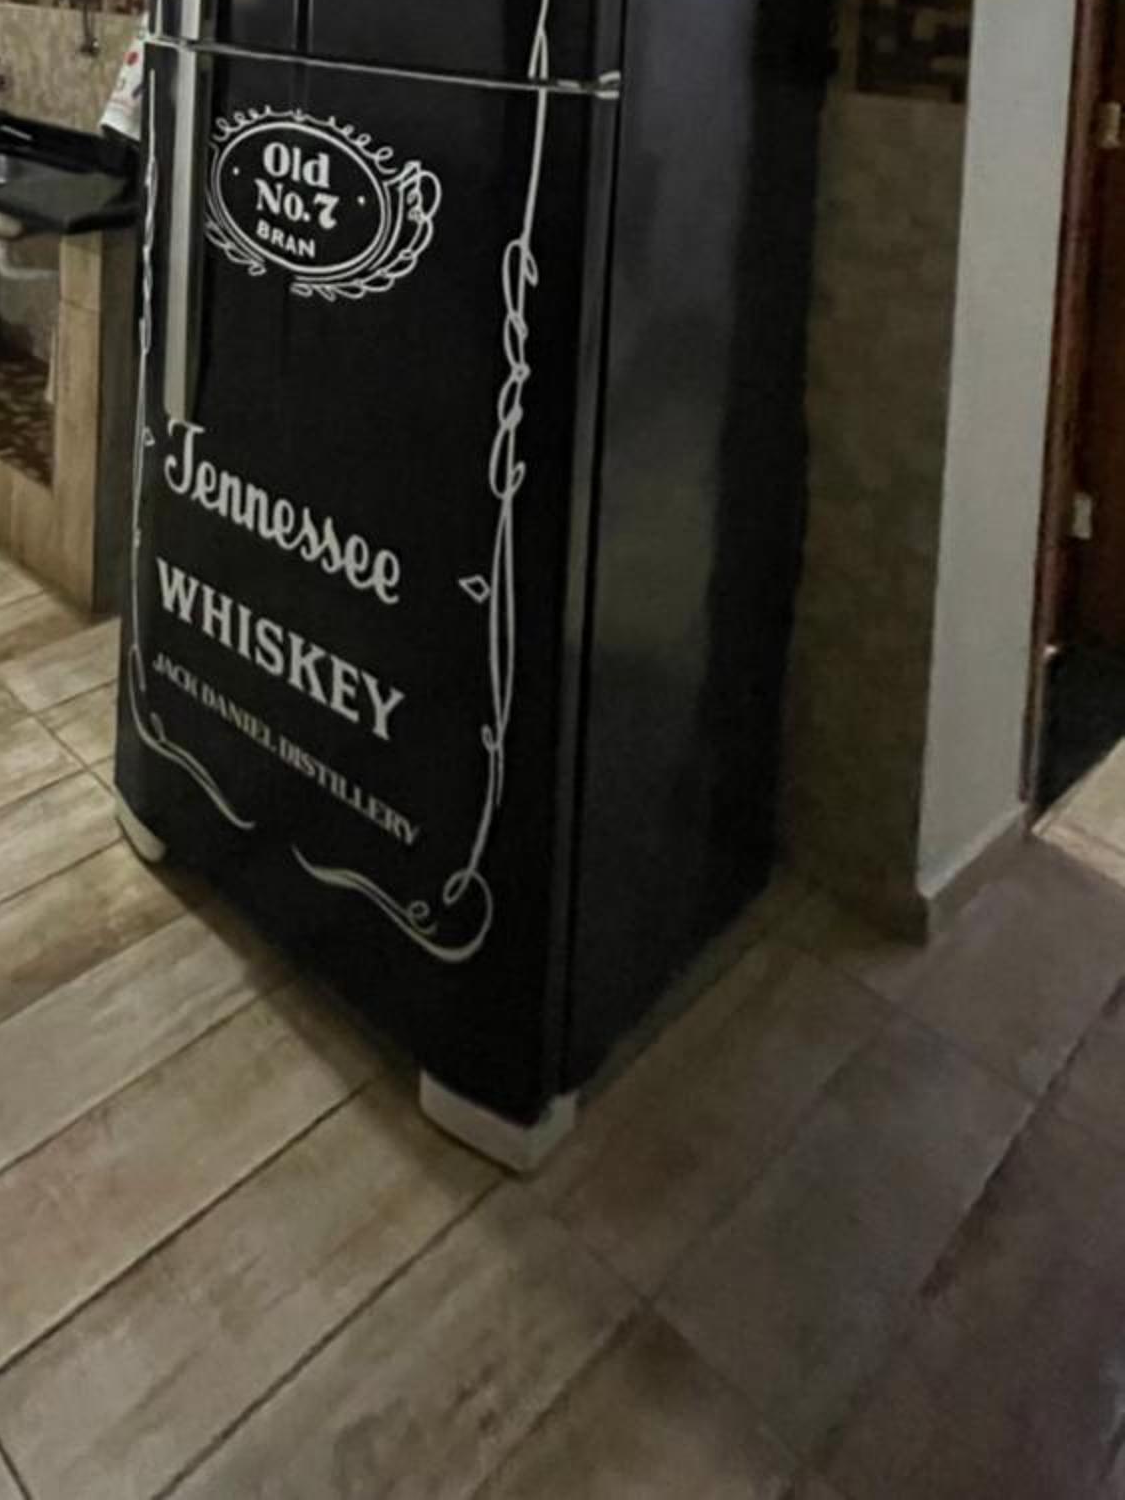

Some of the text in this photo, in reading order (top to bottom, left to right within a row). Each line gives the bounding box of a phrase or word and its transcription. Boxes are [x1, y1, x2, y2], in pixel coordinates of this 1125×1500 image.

[263, 141, 330, 188] Old
[256, 220, 316, 258] BRAN
[156, 557, 406, 741] WHISKEY
[202, 682, 277, 753] DANIEL
[279, 735, 421, 846] DISTILLERY
